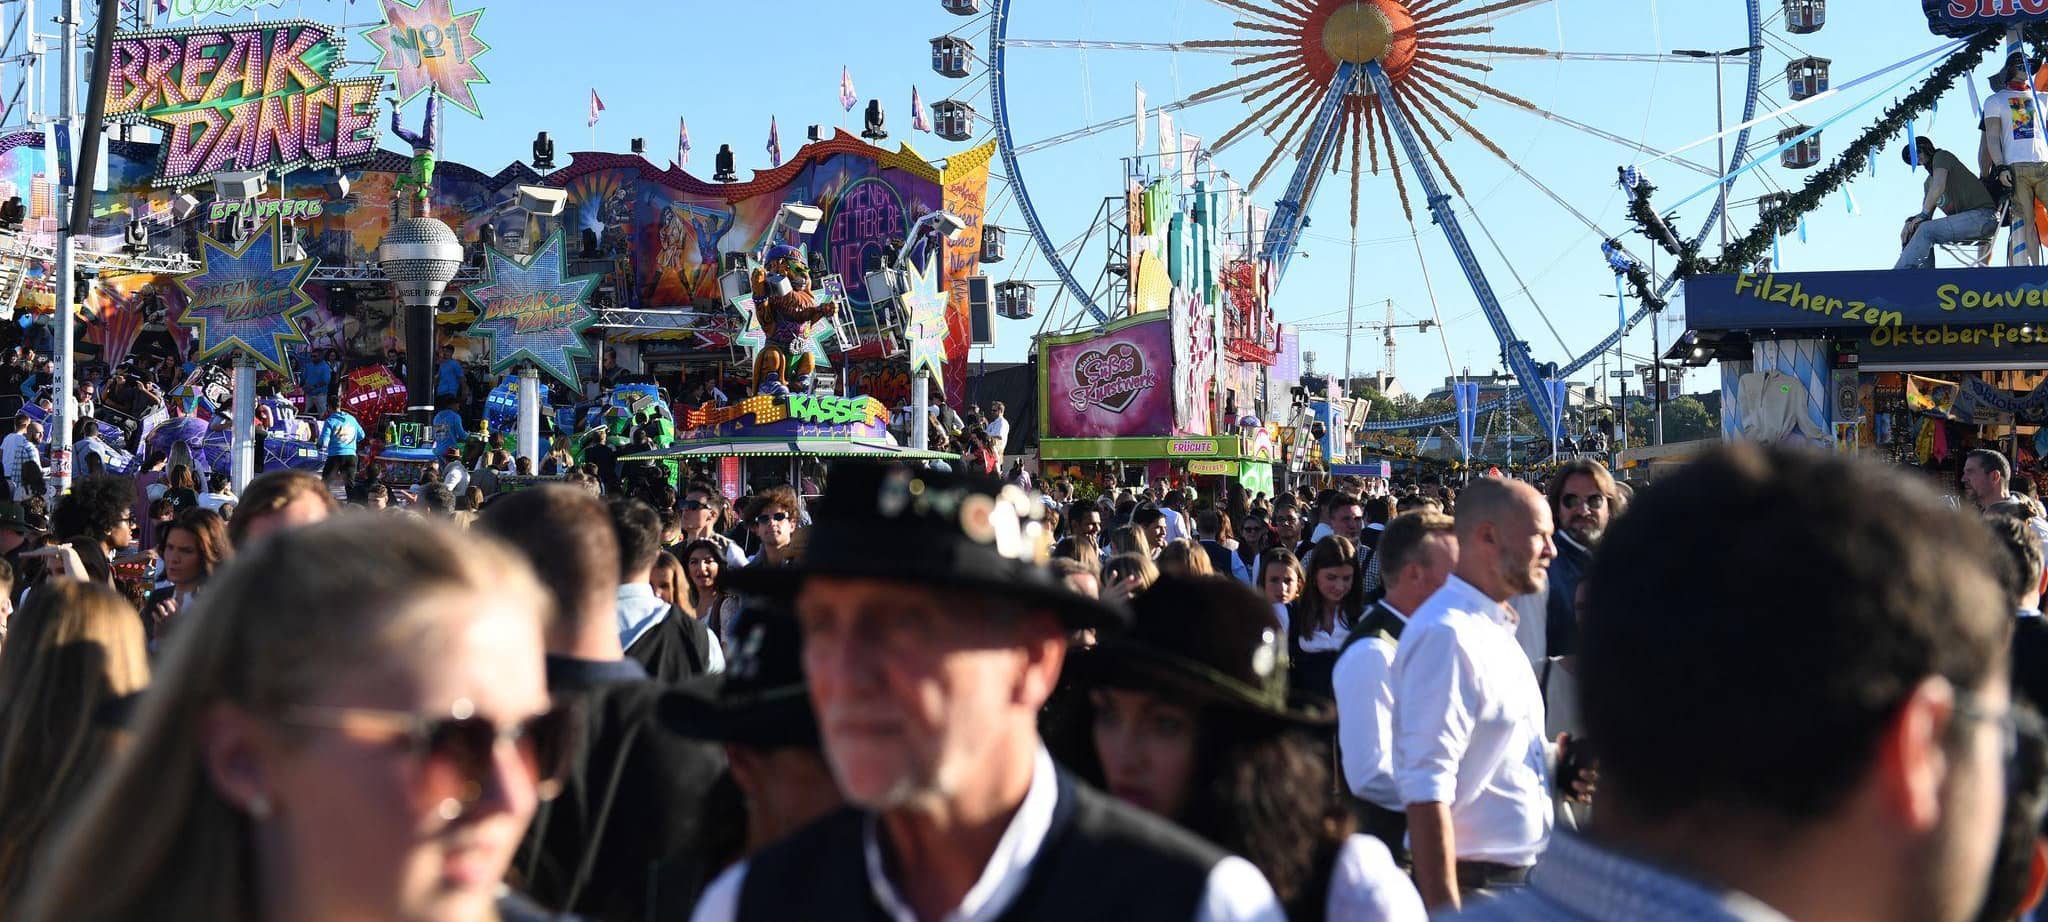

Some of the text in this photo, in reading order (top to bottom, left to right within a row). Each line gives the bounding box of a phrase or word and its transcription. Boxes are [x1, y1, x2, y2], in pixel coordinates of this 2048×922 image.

[103, 26, 330, 116] BREAK
[150, 82, 379, 179] DANCE
[845, 184, 890, 209] THE NEW
[831, 205, 903, 242] LET THERE BE
[194, 279, 263, 306] BREAK
[225, 288, 290, 321] DANCE
[485, 291, 549, 320] BREAK
[1736, 272, 1903, 326] Filzherzen
[515, 303, 578, 332] DANCE
[1870, 323, 2048, 348] Oktoberfest
[1069, 368, 1155, 412] Kunstwerk
[789, 394, 868, 423] KASSE
[1173, 441, 1213, 453] FRÜCHTE
